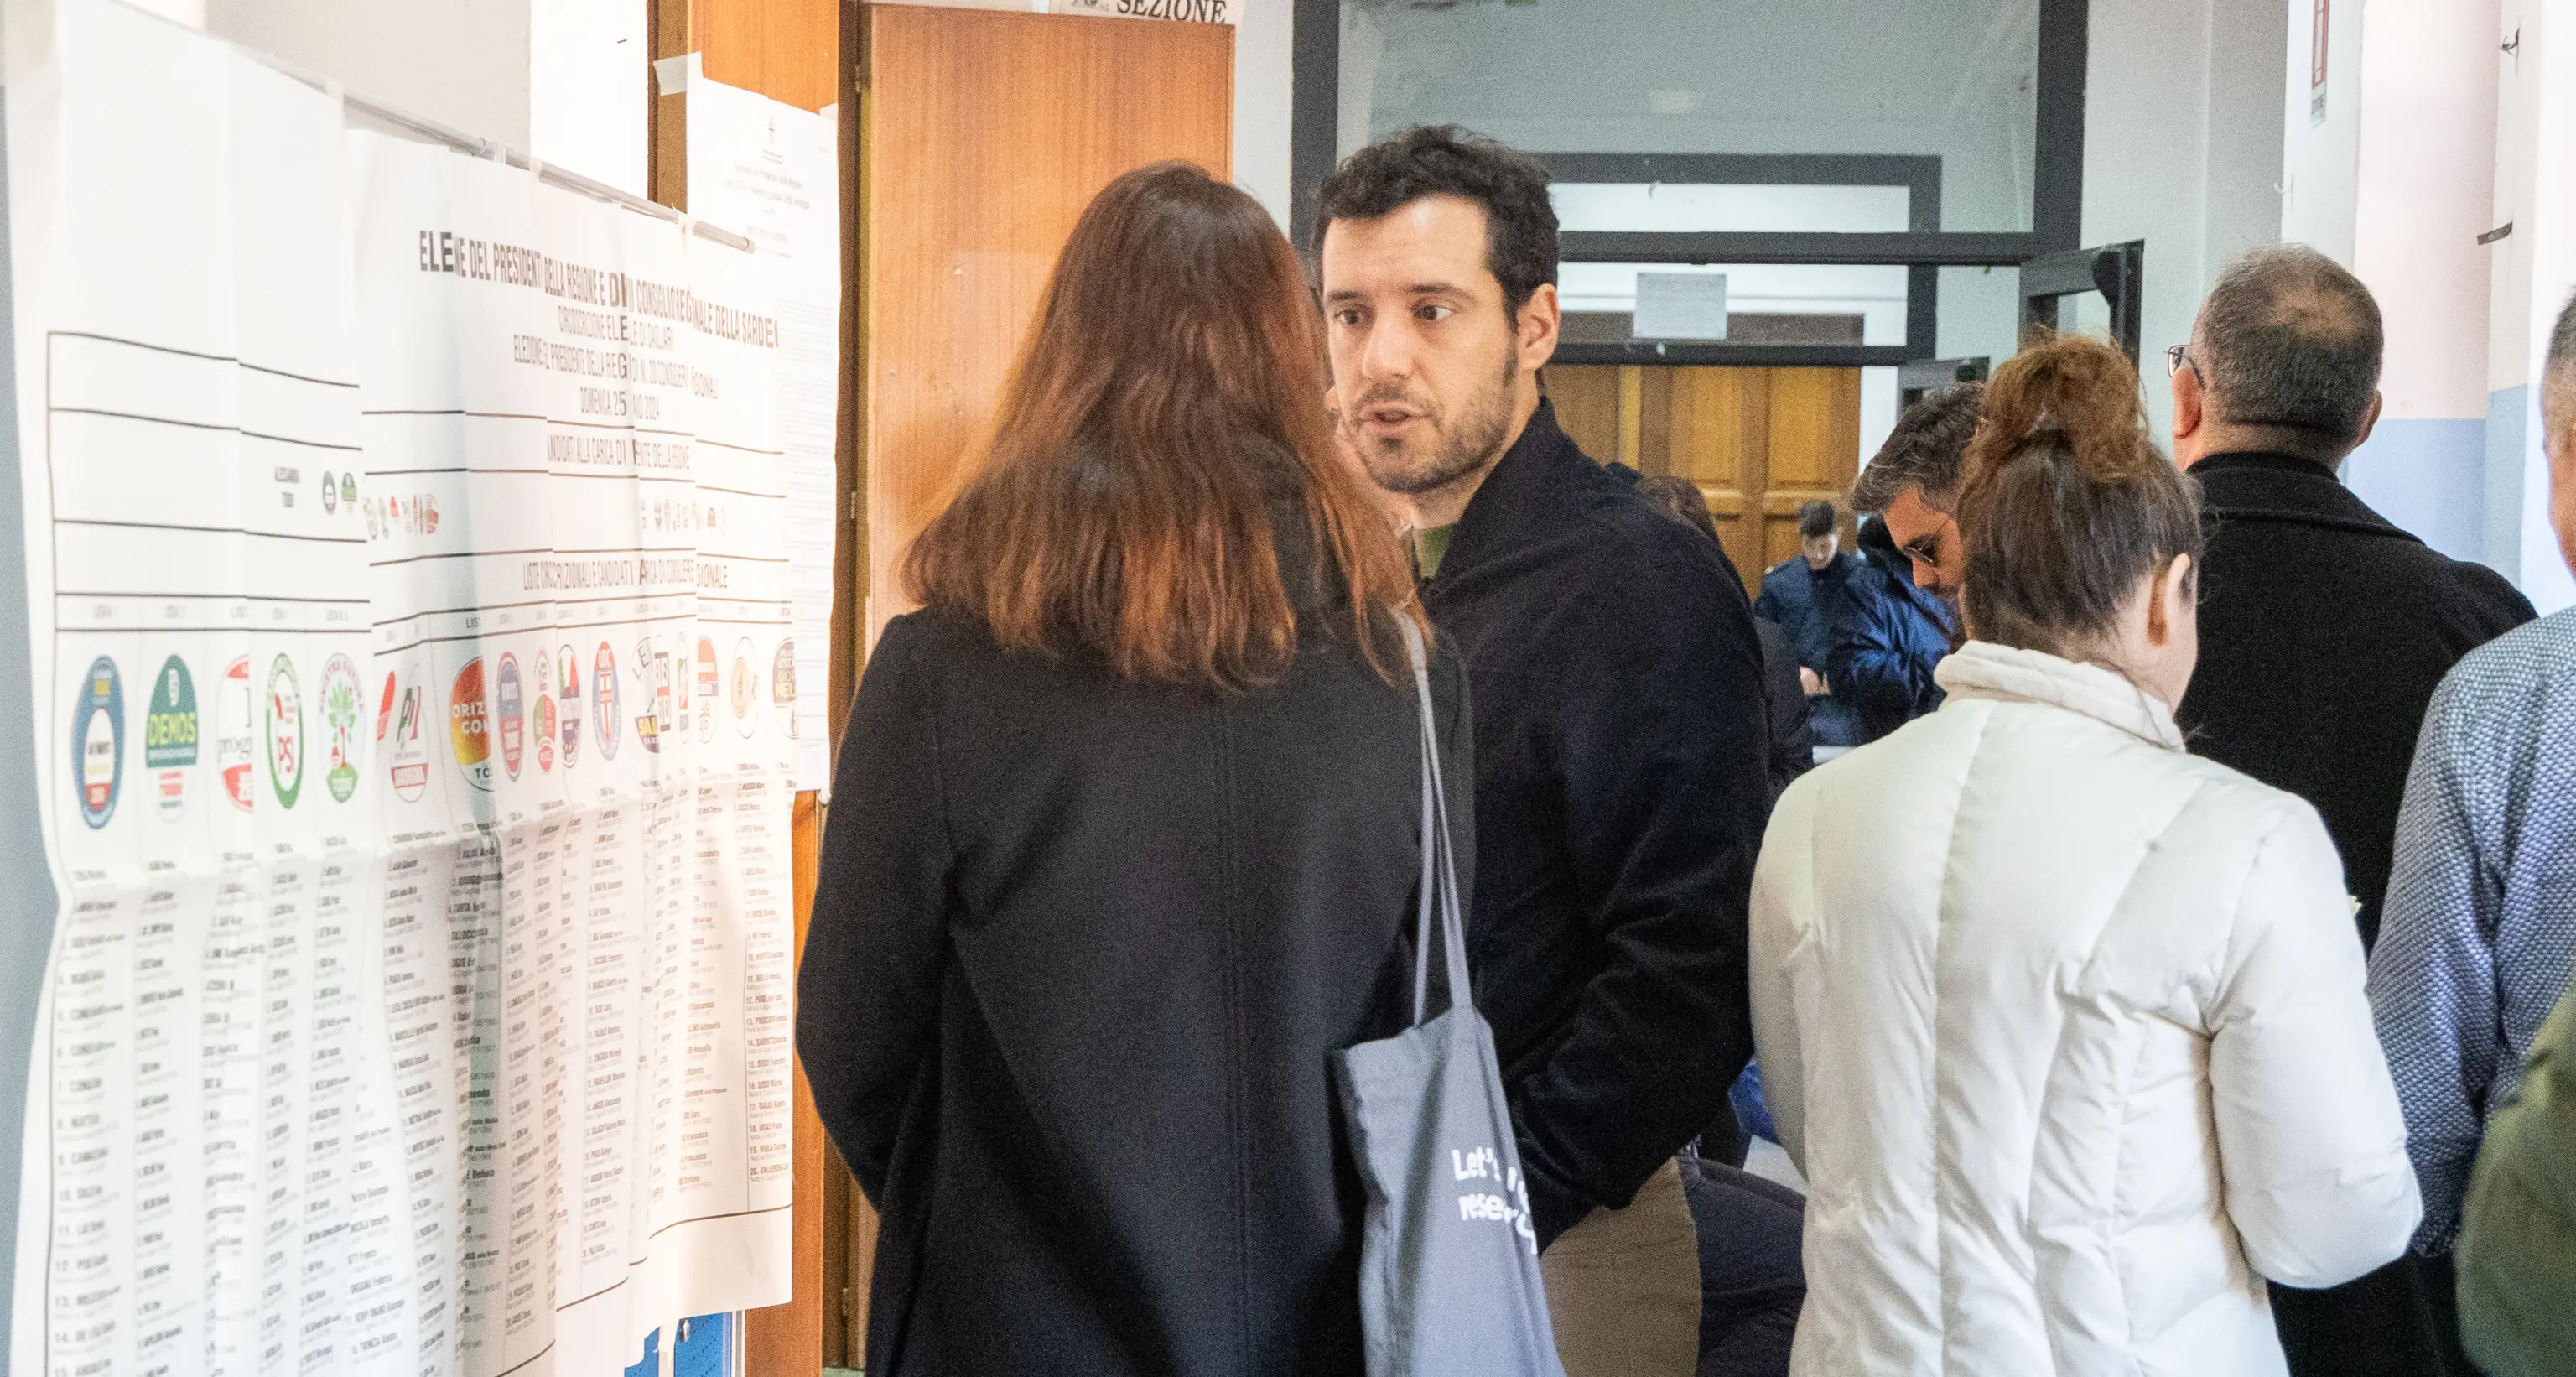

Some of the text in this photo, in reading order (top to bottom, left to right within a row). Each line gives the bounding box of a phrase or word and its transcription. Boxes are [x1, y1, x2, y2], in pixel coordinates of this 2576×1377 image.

[469, 238, 491, 281] DEL
[493, 242, 543, 289] PRESIDENT
[715, 304, 740, 342] DELLA
[613, 390, 627, 417] 25
[147, 713, 196, 745] DEMOS
